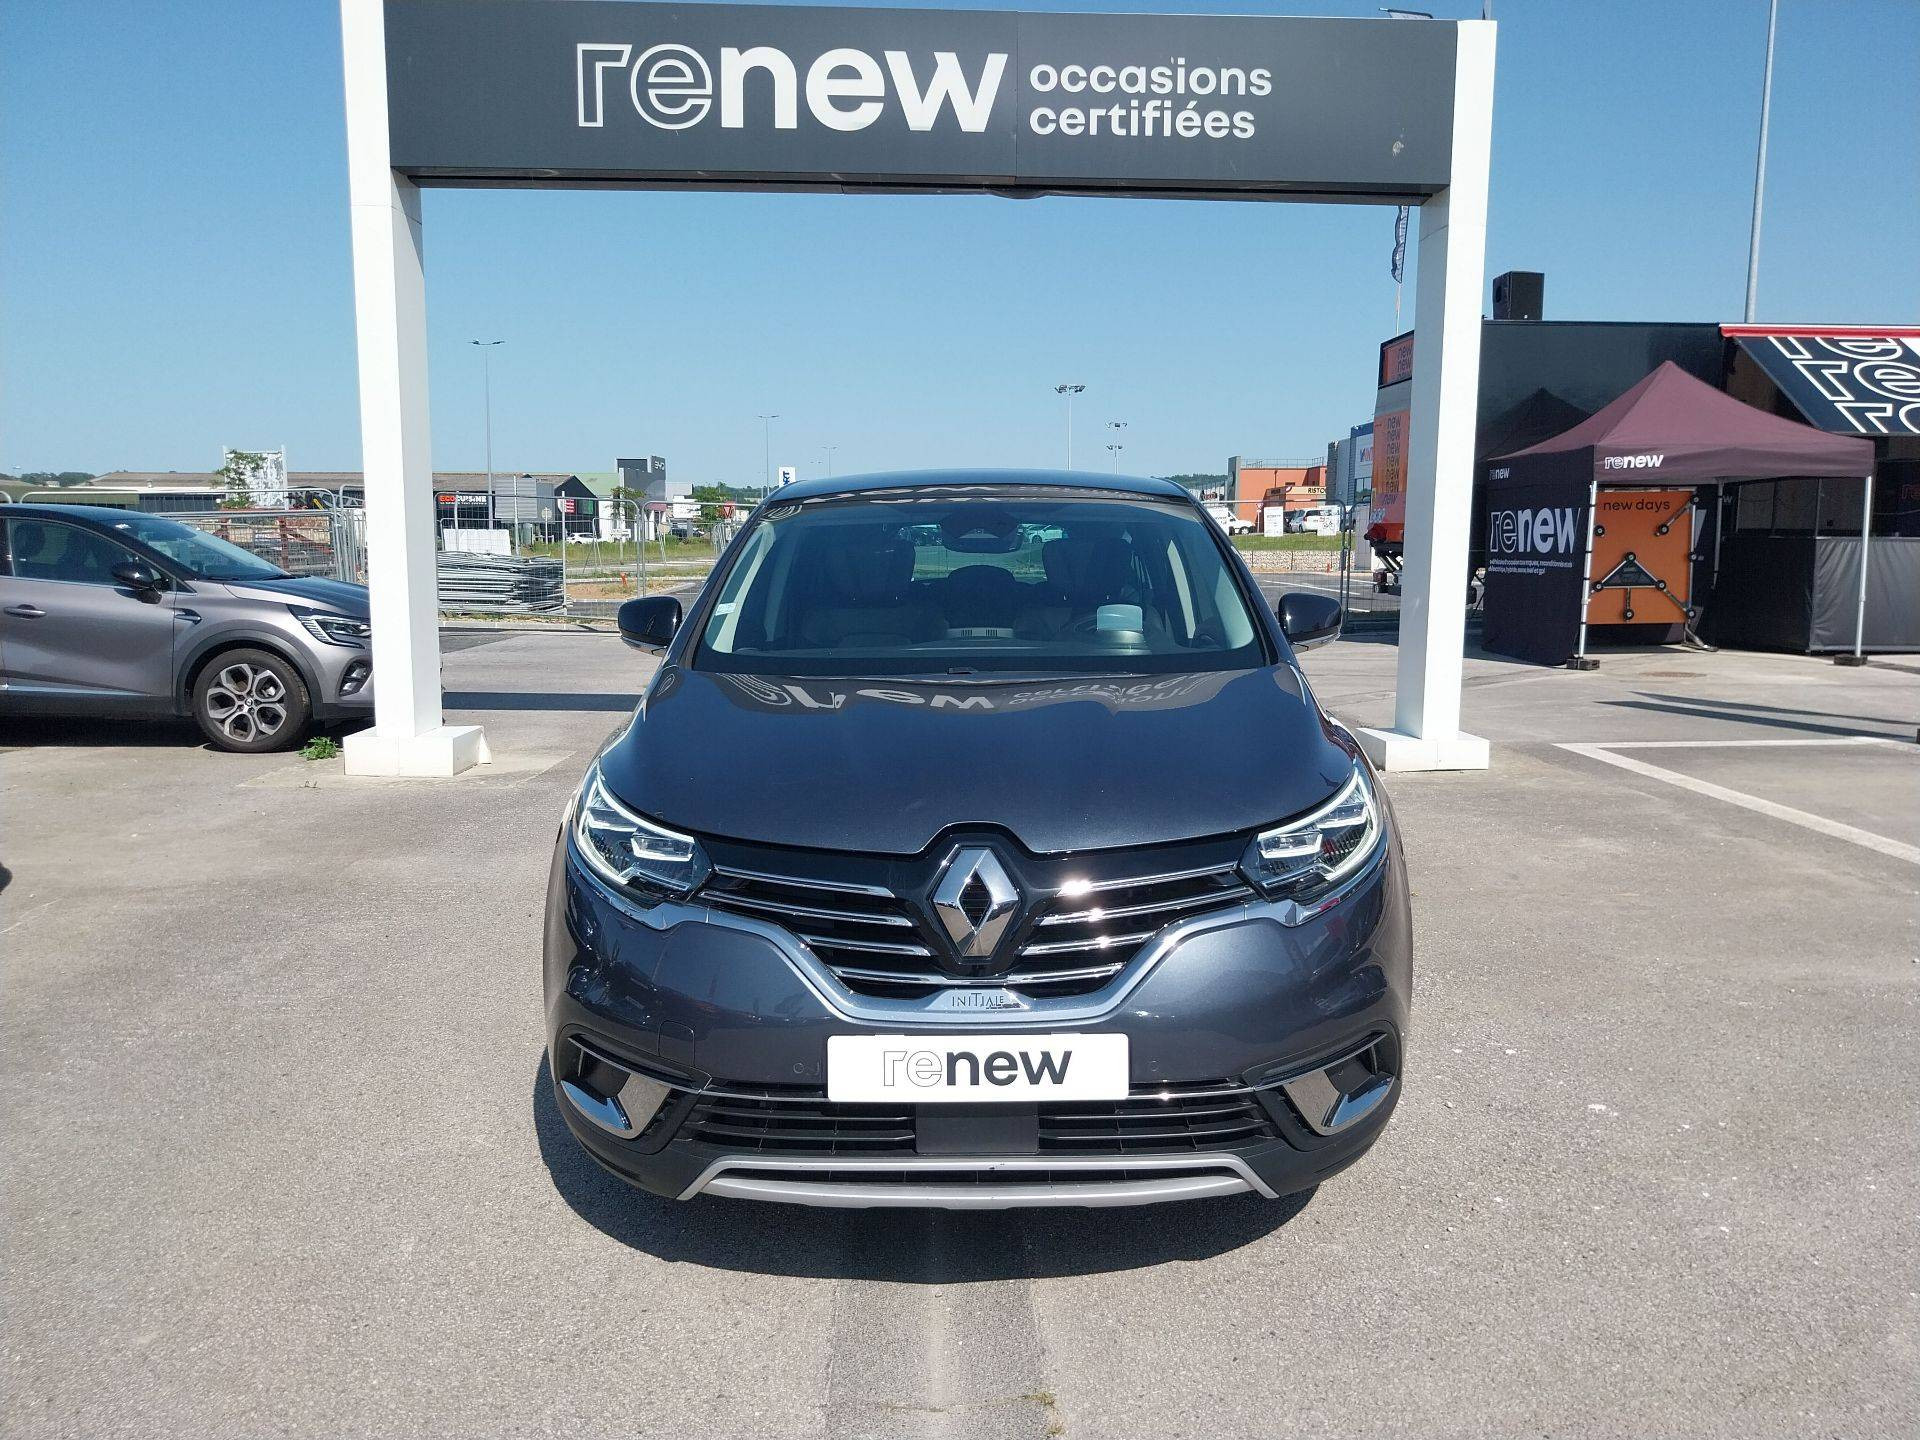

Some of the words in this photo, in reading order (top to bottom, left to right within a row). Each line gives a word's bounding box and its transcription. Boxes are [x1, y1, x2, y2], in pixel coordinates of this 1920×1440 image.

[576, 43, 1009, 133] renew
[1029, 56, 1273, 98] occasions
[1029, 99, 1255, 139] certifiées
[1490, 468, 1510, 481] renew
[1604, 455, 1664, 469] renew
[1603, 501, 1633, 511] new
[1635, 498, 1671, 513] days
[1490, 508, 1580, 554] renew
[952, 993, 1004, 1007] INITIALE
[883, 1050, 1073, 1087] renew
